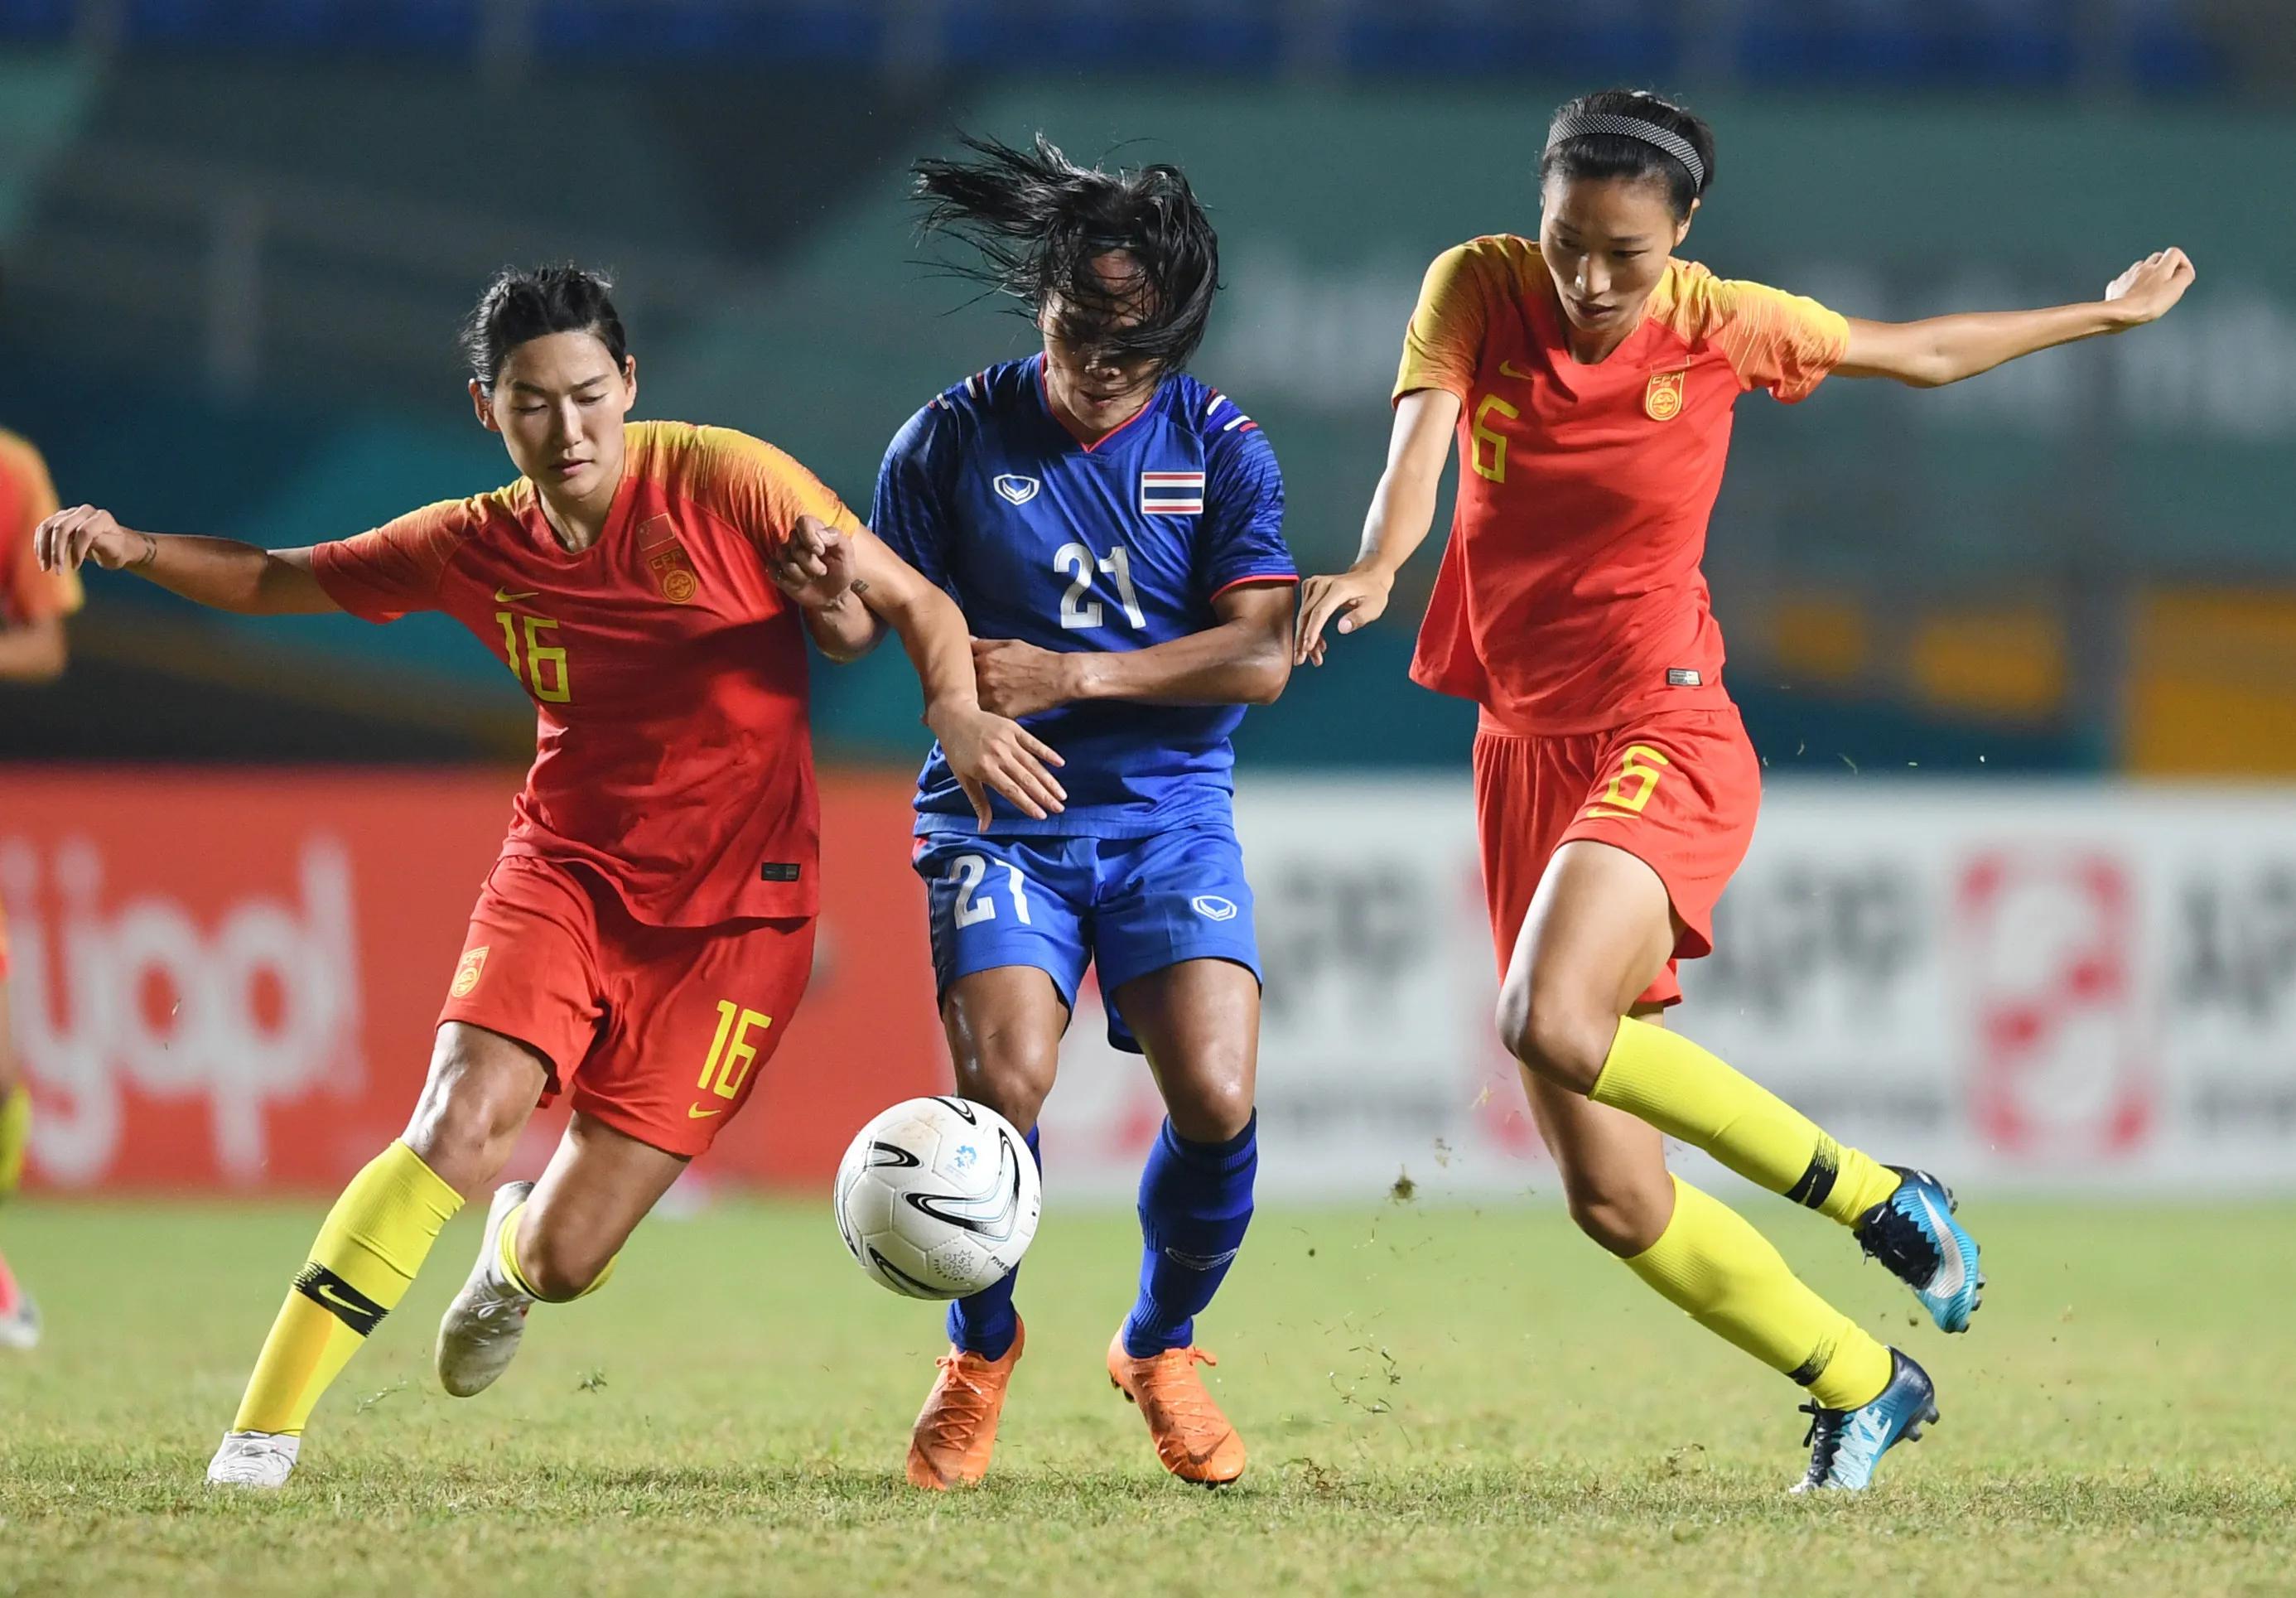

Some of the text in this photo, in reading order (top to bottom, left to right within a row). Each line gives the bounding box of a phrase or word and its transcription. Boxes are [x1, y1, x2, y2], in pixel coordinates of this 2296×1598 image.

[1472, 393, 1520, 484] 6
[1054, 543, 1147, 630] 21
[495, 611, 572, 702] 16
[1601, 745, 1670, 813] 6
[697, 999, 772, 1100] 16
